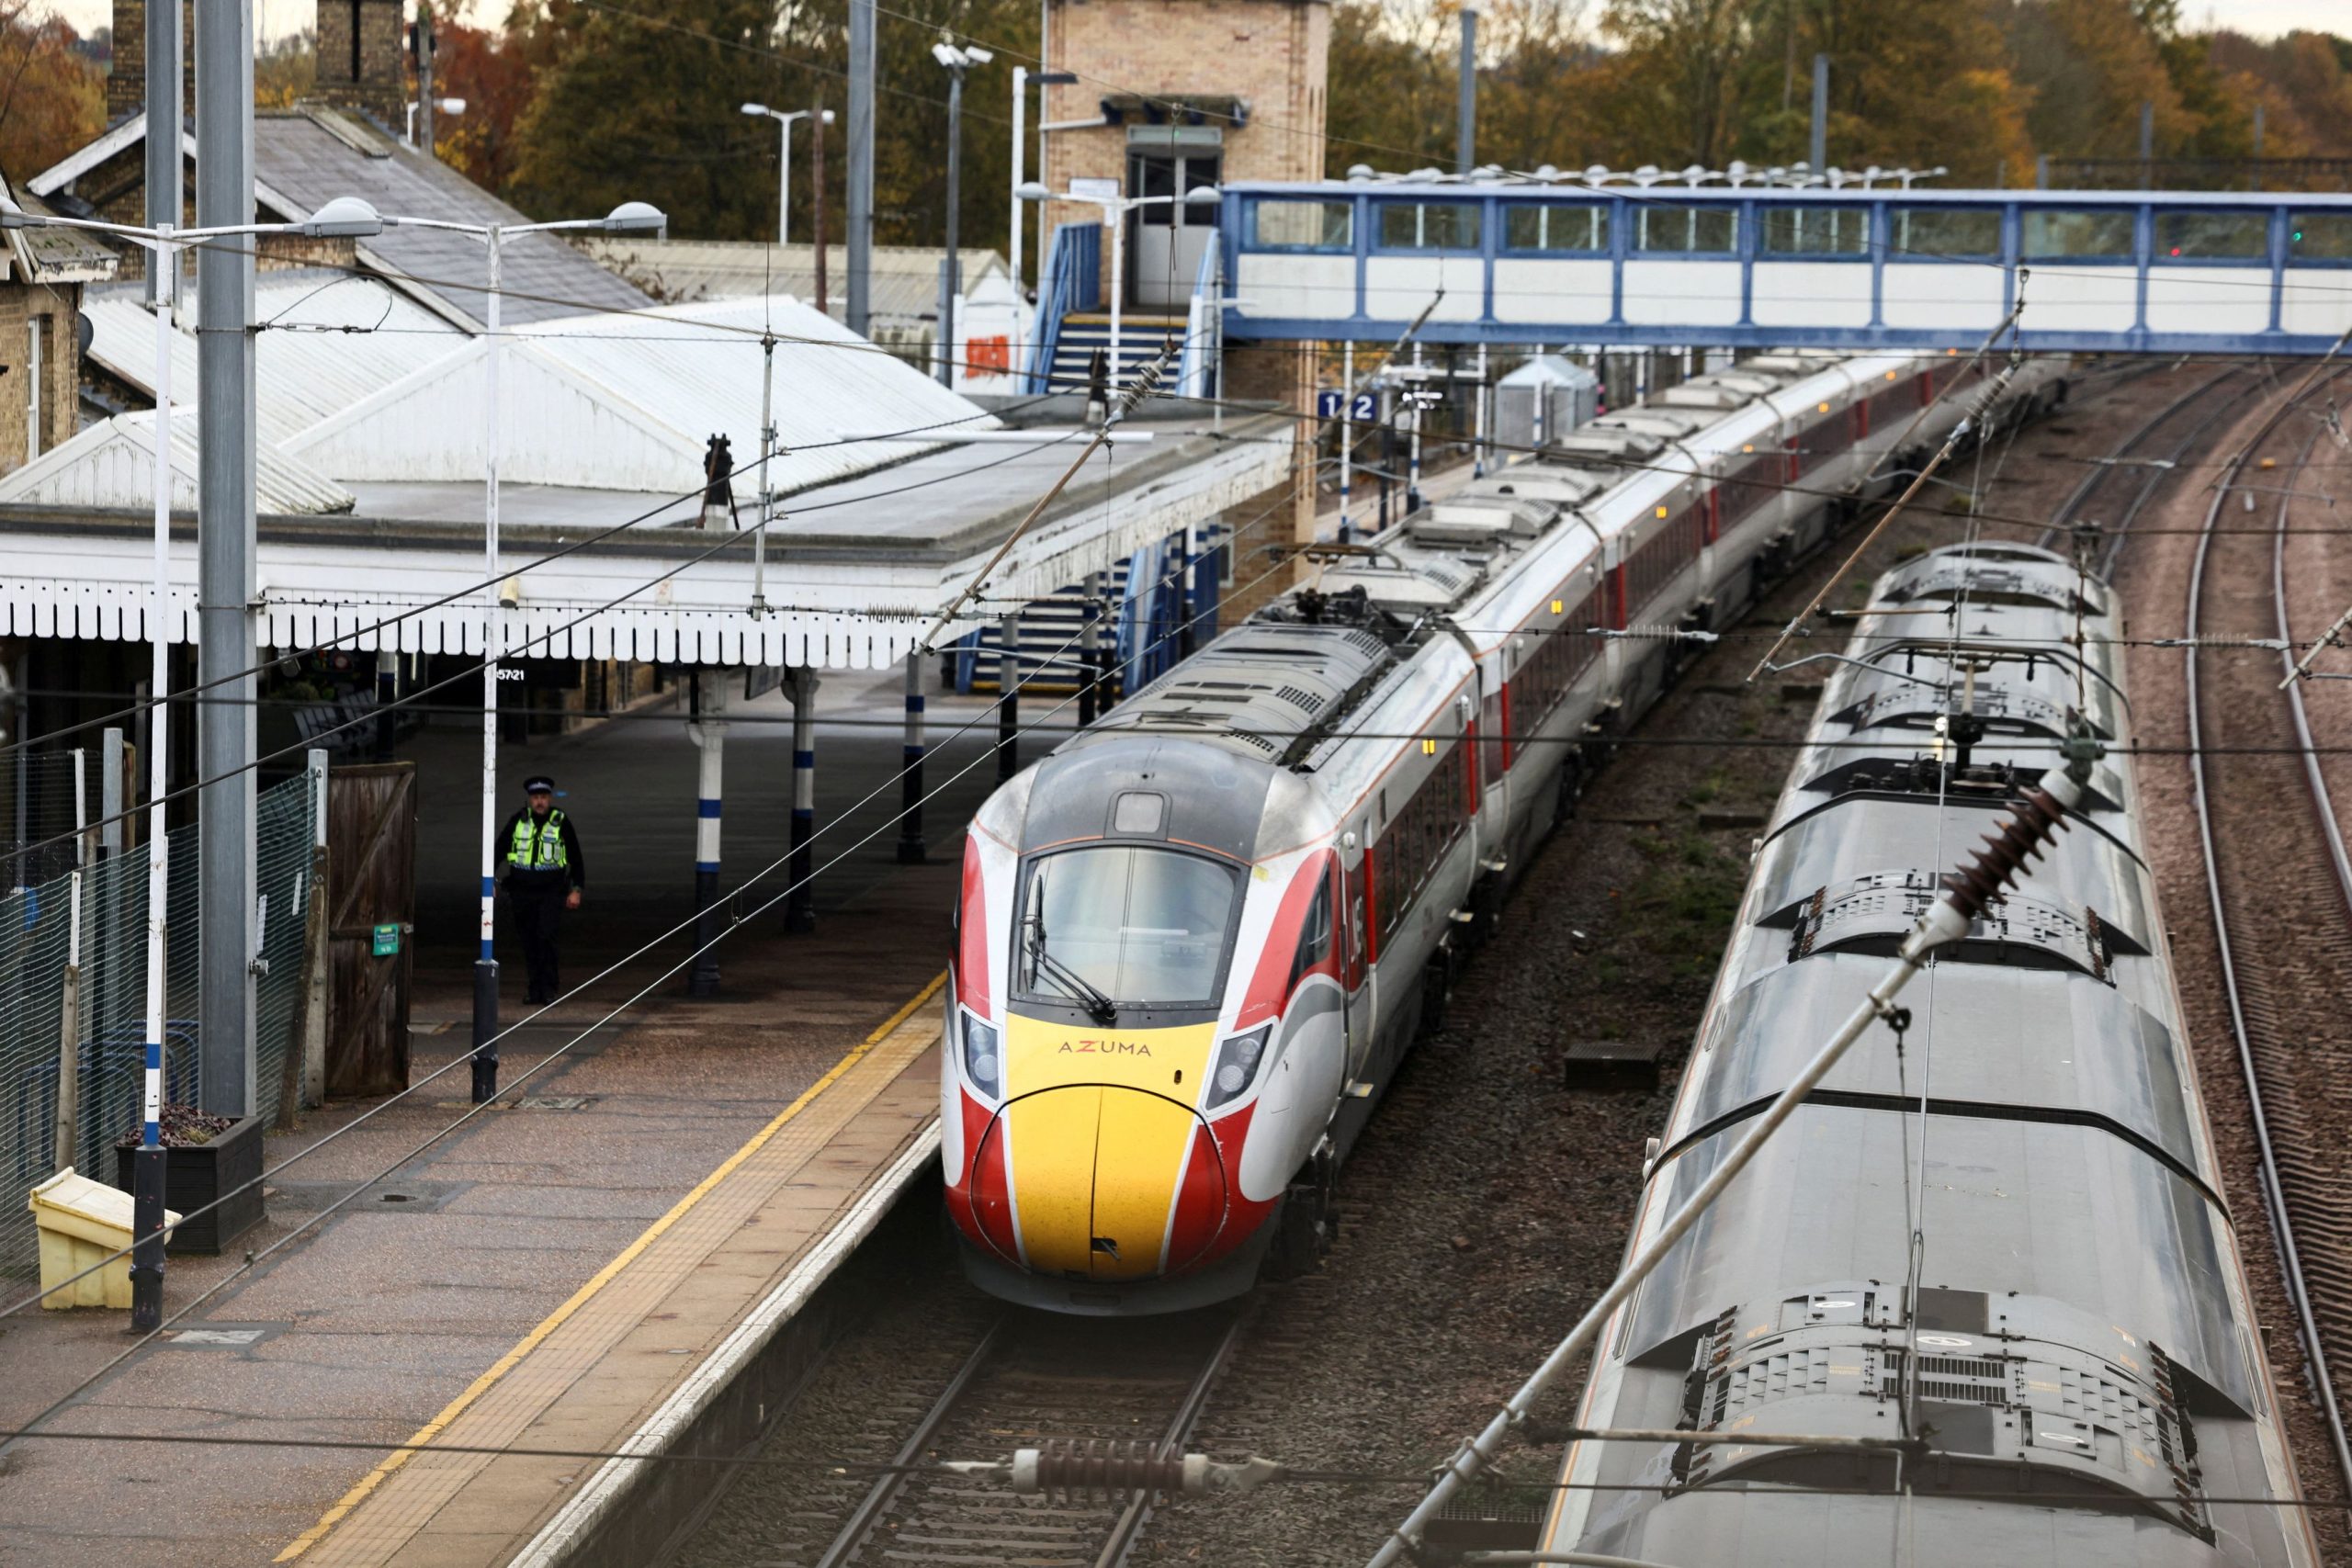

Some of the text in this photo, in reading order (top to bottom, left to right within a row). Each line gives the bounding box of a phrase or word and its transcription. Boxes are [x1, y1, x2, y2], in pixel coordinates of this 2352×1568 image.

[1326, 395, 1373, 419] 1 2
[1058, 1041, 1151, 1057] AZUMA
